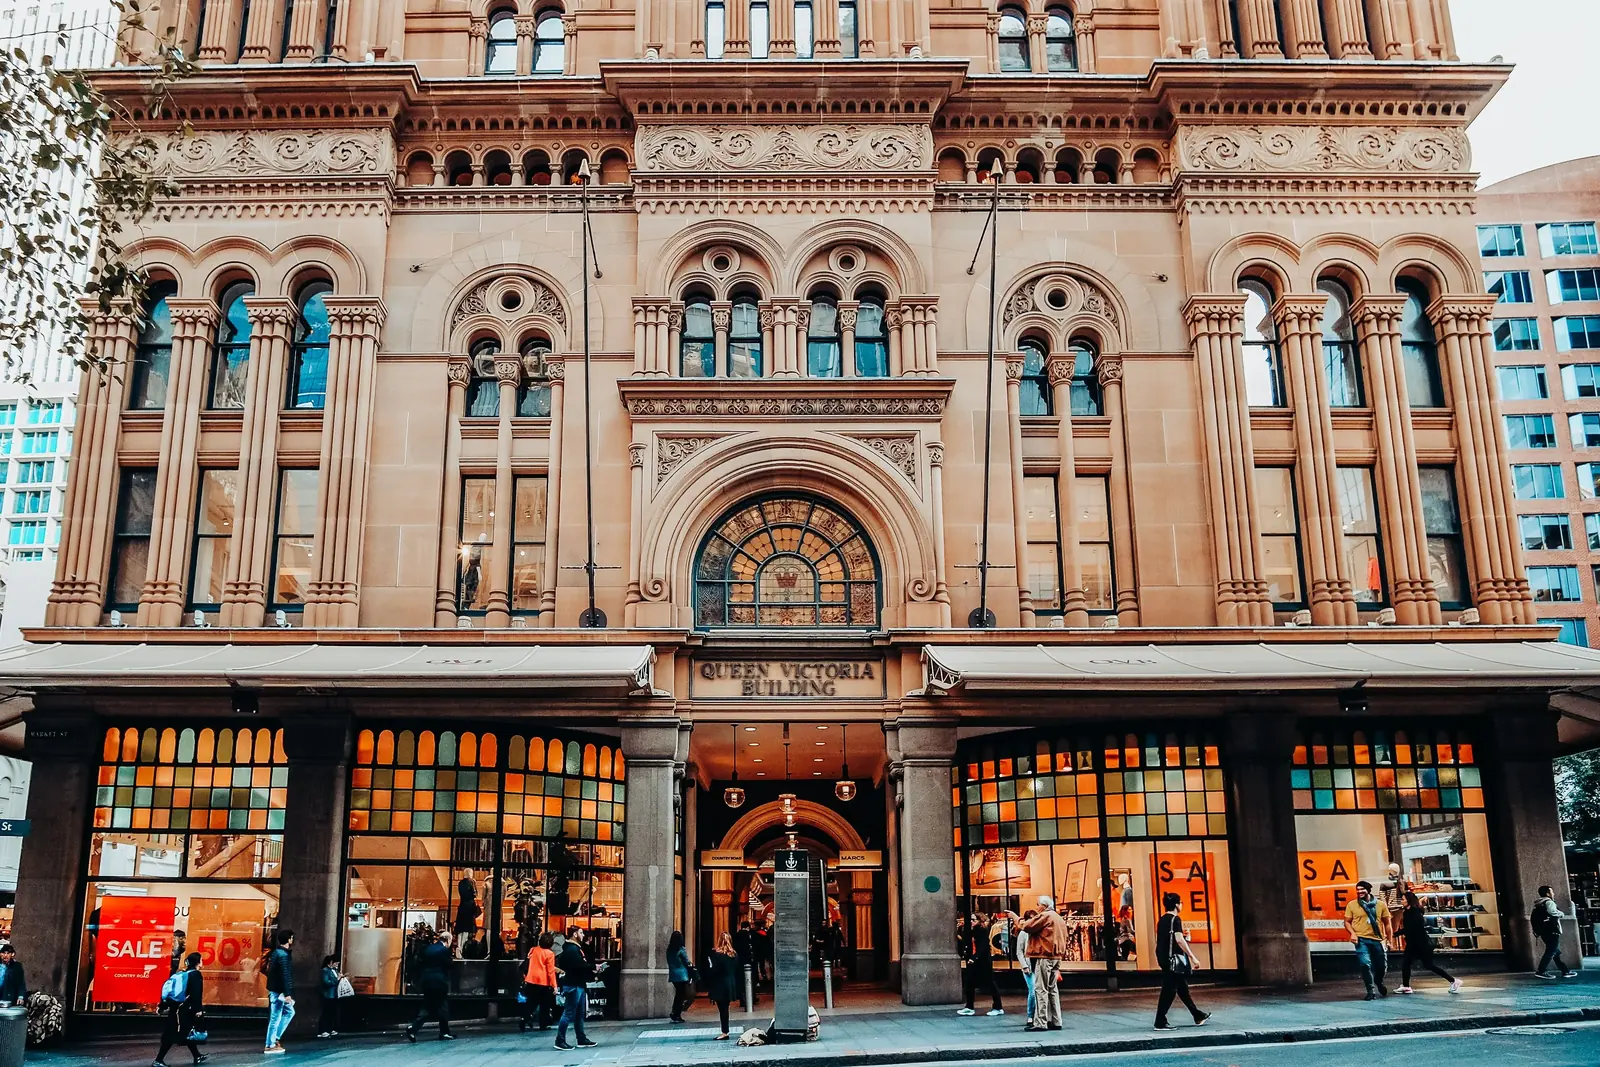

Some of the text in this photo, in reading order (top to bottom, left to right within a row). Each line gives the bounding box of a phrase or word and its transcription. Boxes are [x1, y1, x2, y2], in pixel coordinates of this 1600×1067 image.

[700, 662, 875, 680] QUEEN VICTORIA
[741, 679, 836, 696] BUILDING
[1, 821, 13, 831] St
[106, 939, 164, 959] SALE
